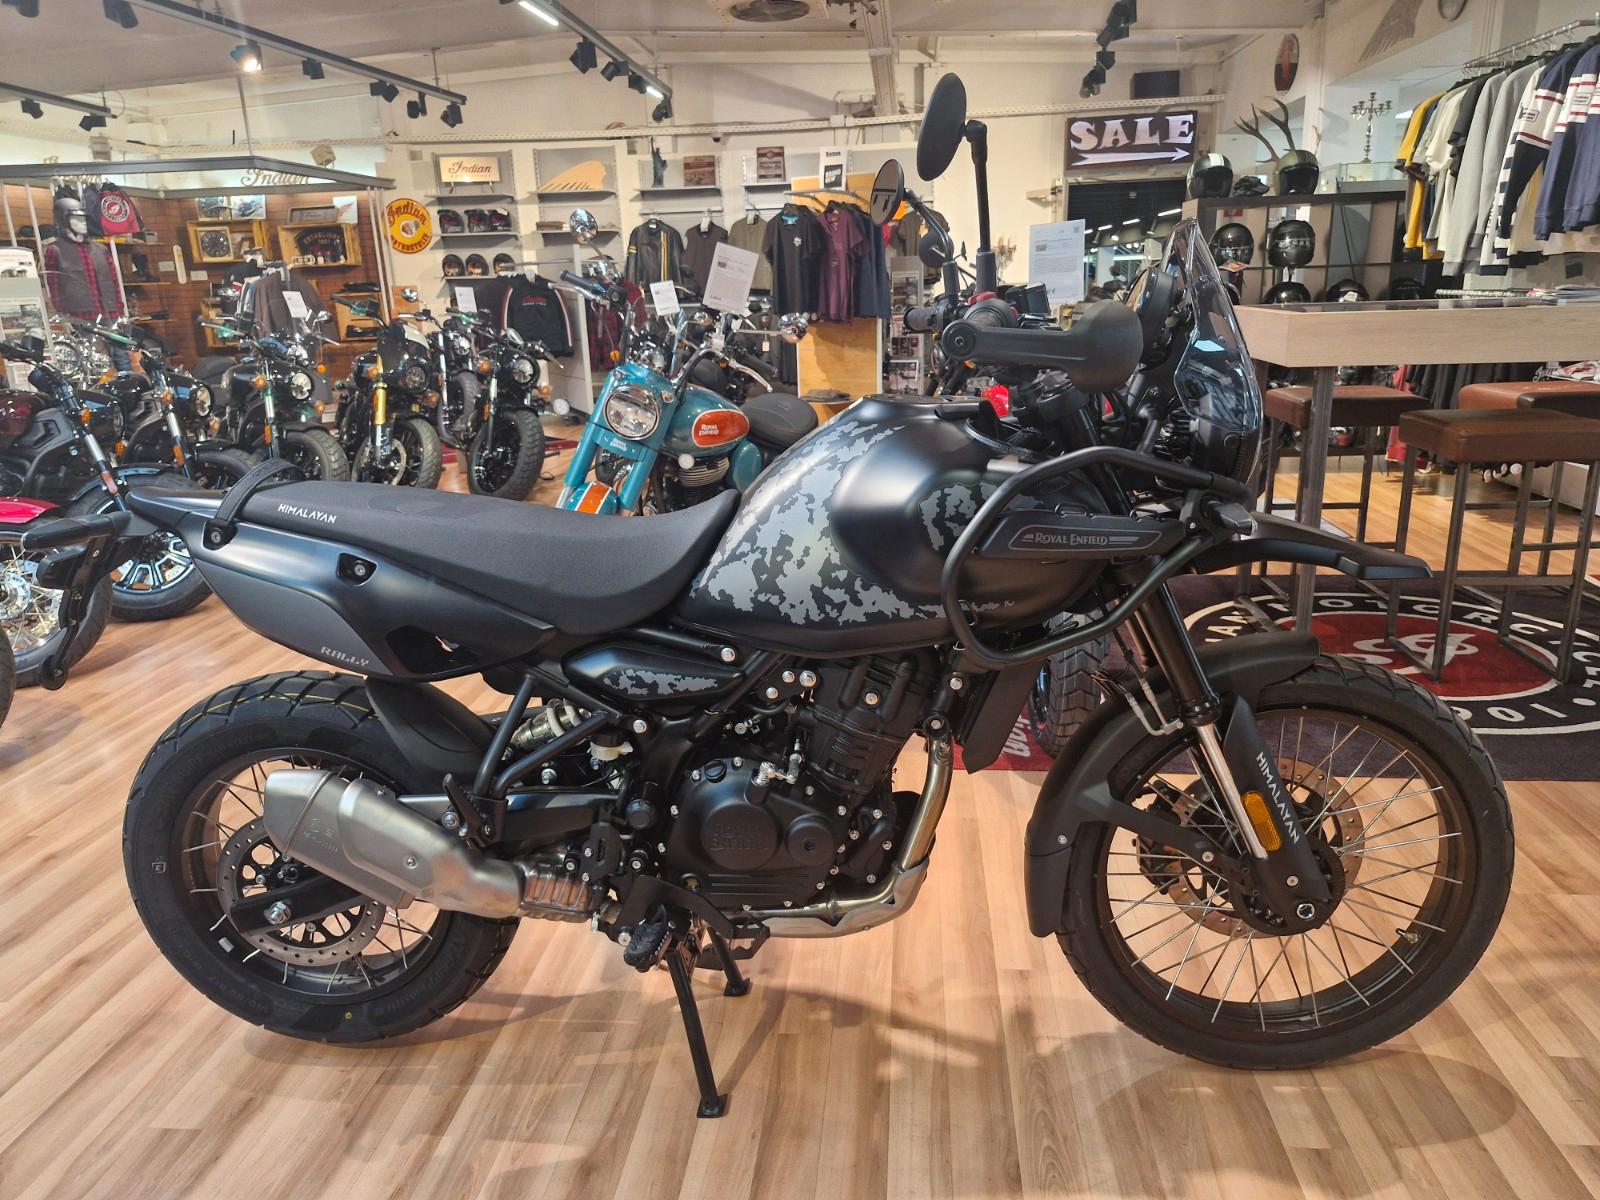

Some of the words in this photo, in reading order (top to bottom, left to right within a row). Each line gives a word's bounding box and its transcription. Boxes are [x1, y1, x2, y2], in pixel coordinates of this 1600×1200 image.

[1070, 114, 1194, 151] SALE
[448, 160, 492, 174] Indian
[387, 201, 427, 228] Indian
[277, 503, 337, 524] HIMALAYAN
[1035, 532, 1069, 544] ROYAL
[1069, 533, 1109, 546] ENFIELD
[320, 646, 369, 667] RALLY
[1256, 751, 1300, 844] HIMALAYAN
